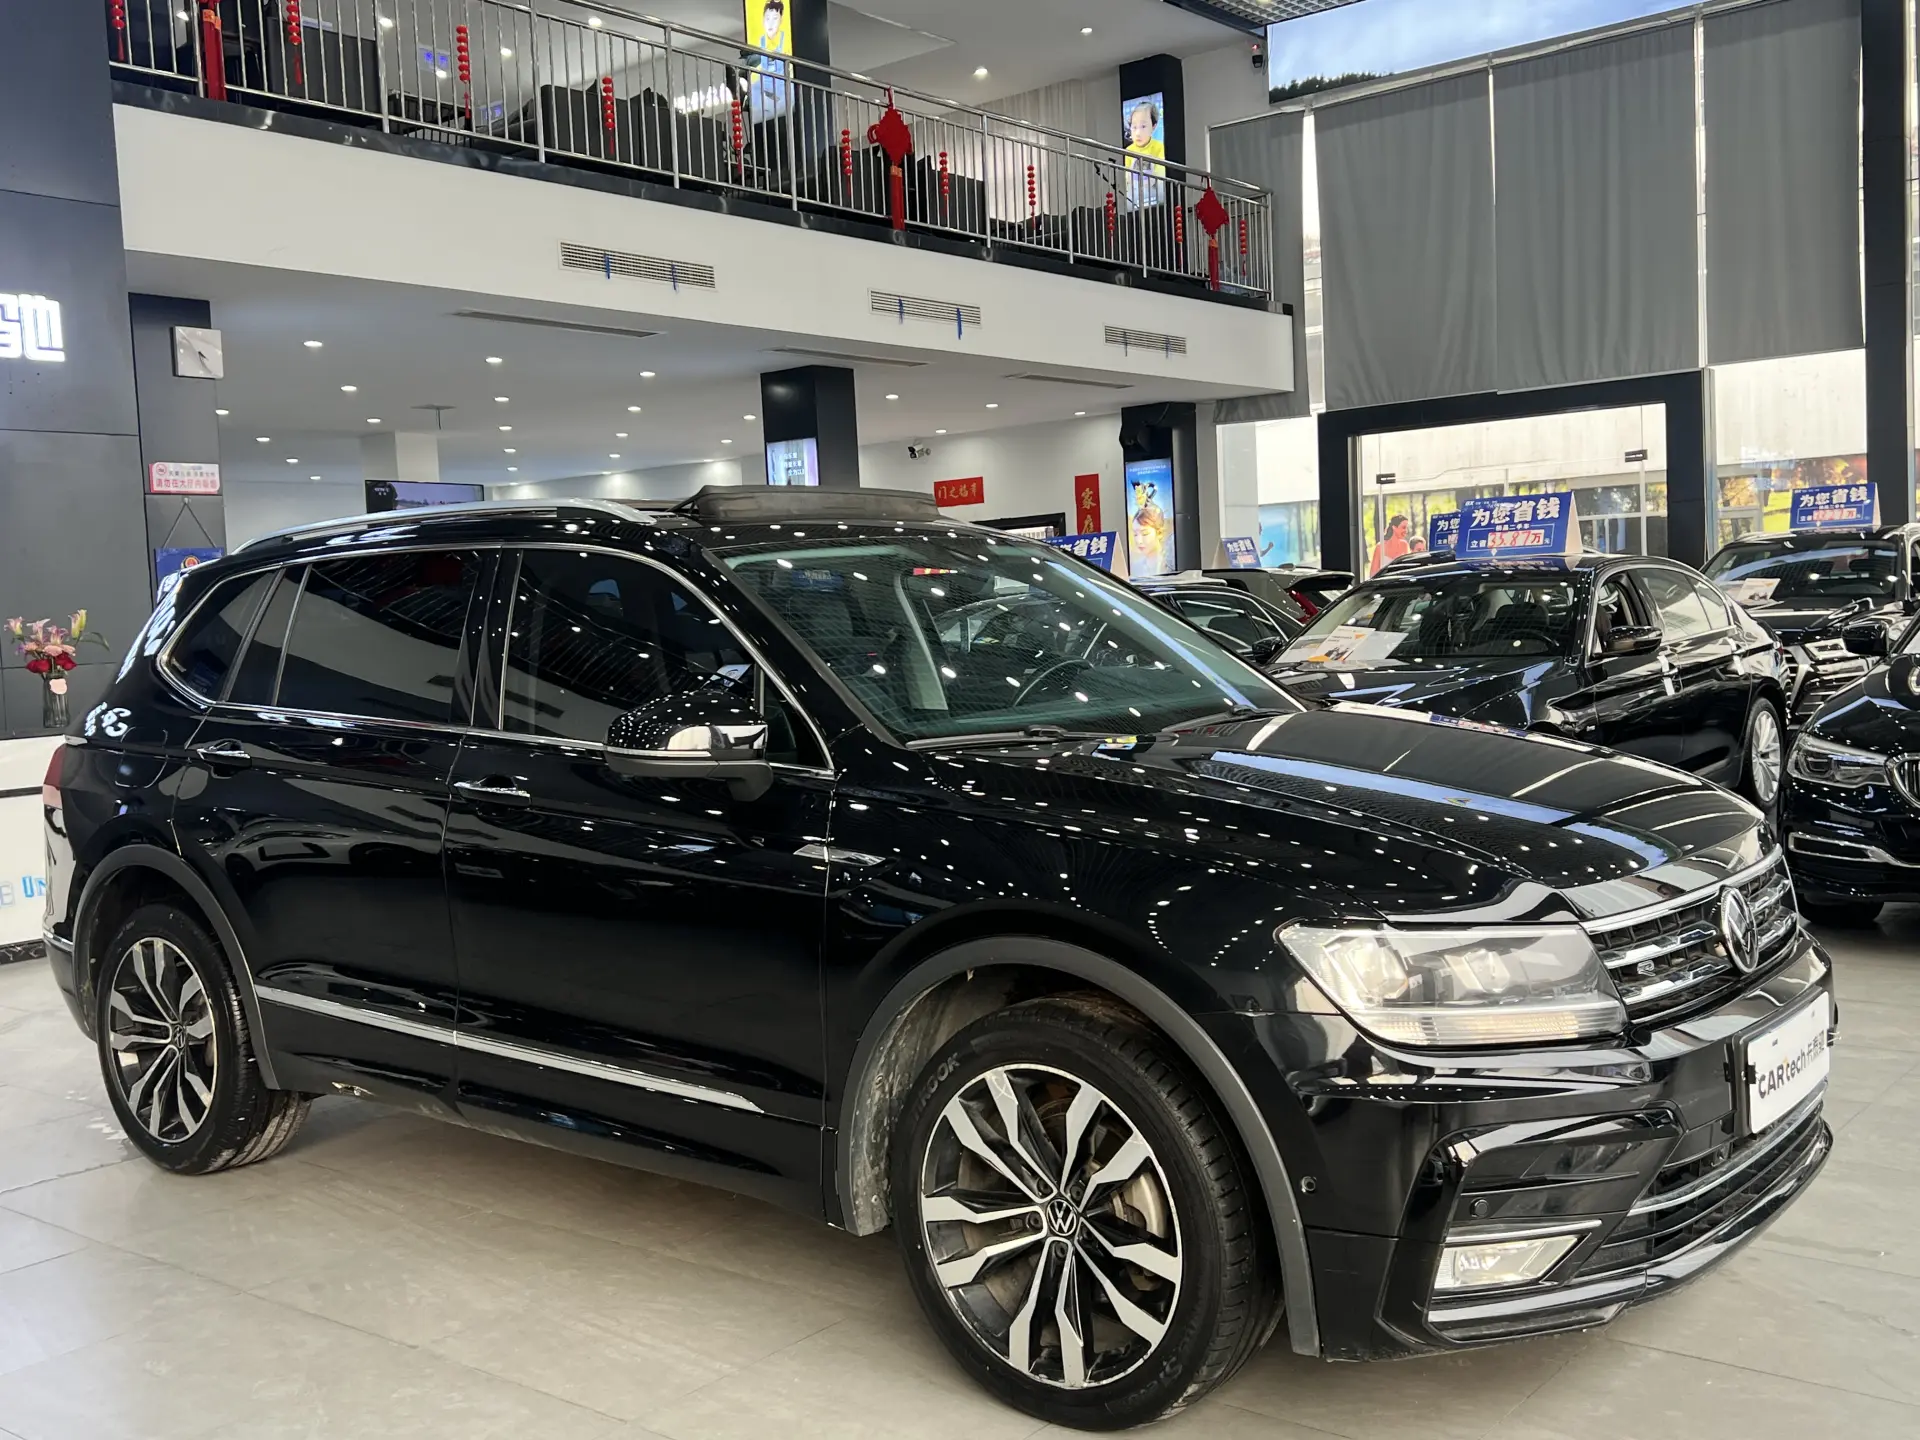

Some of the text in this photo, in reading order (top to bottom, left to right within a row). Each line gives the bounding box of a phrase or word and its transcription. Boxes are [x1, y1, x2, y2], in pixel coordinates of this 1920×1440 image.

[1800, 486, 1868, 507] 为您省钱
[1470, 497, 1560, 528] 为您省钱
[1758, 1048, 1807, 1099] CARtech
